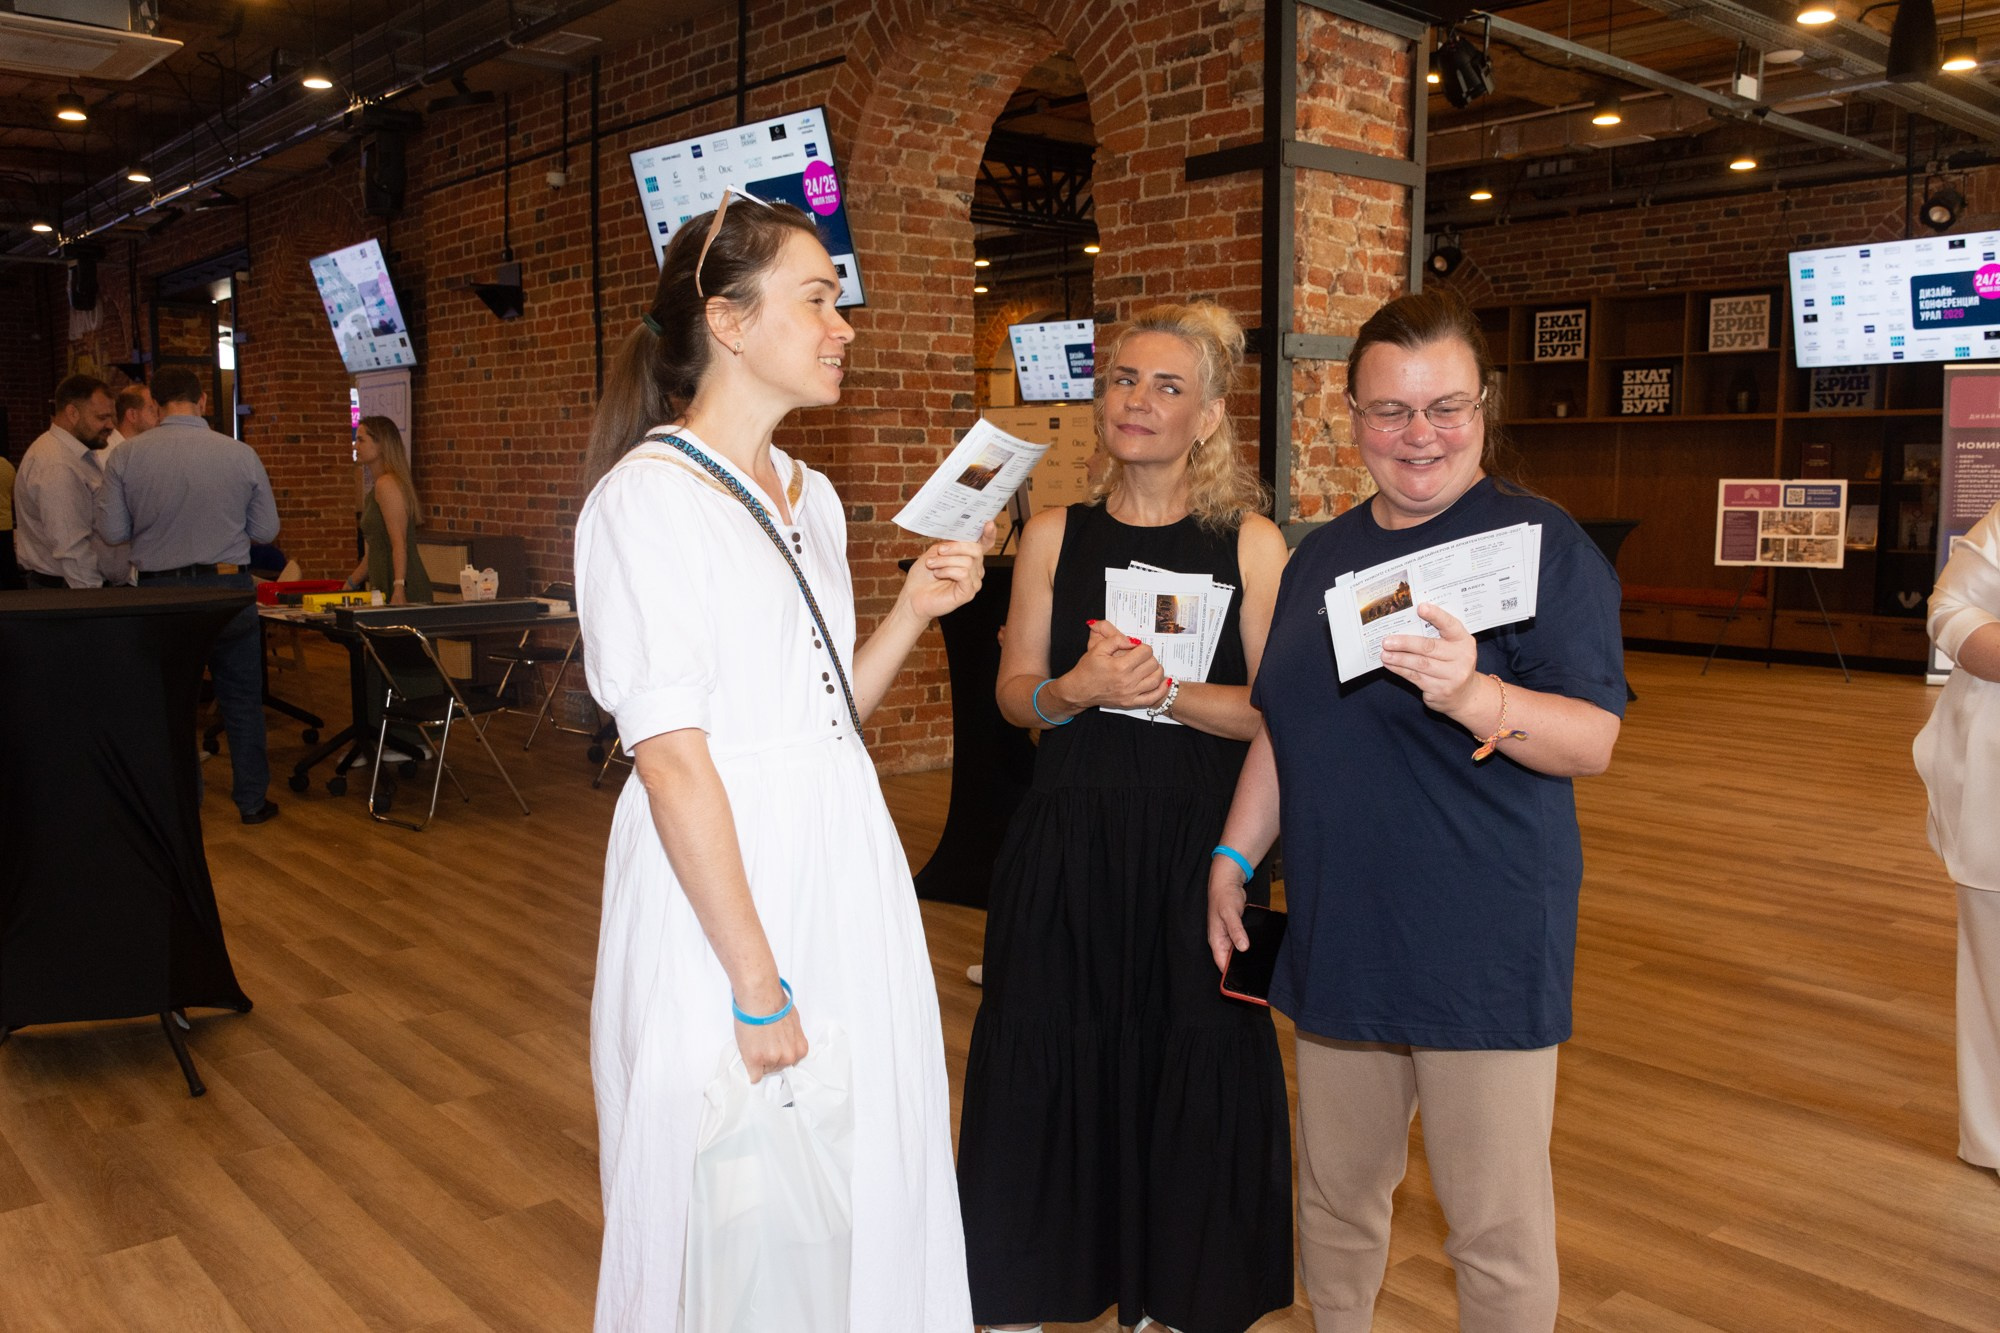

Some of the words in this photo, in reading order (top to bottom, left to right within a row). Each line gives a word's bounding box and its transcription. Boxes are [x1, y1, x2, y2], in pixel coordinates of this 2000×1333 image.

[804, 173, 838, 197] 24/25
[1919, 285, 1956, 300] ДИЗАЙН-
[1711, 299, 1767, 317] ЕКАТ
[1919, 296, 1980, 310] КОНФЕРЕНЦИЯ
[1538, 313, 1582, 329] ЕКАТ
[1920, 310, 1942, 321] УРАЛ
[1712, 315, 1766, 333] ЕРИН
[1538, 328, 1582, 344] ЕРИН
[1711, 331, 1766, 349] БУРГ
[1537, 343, 1582, 358] БУРГ
[1622, 368, 1672, 385] ЕКАТ
[1814, 375, 1871, 392] ЕРИН
[1621, 384, 1671, 399] ЕРИН
[1621, 398, 1670, 414] БУРГ
